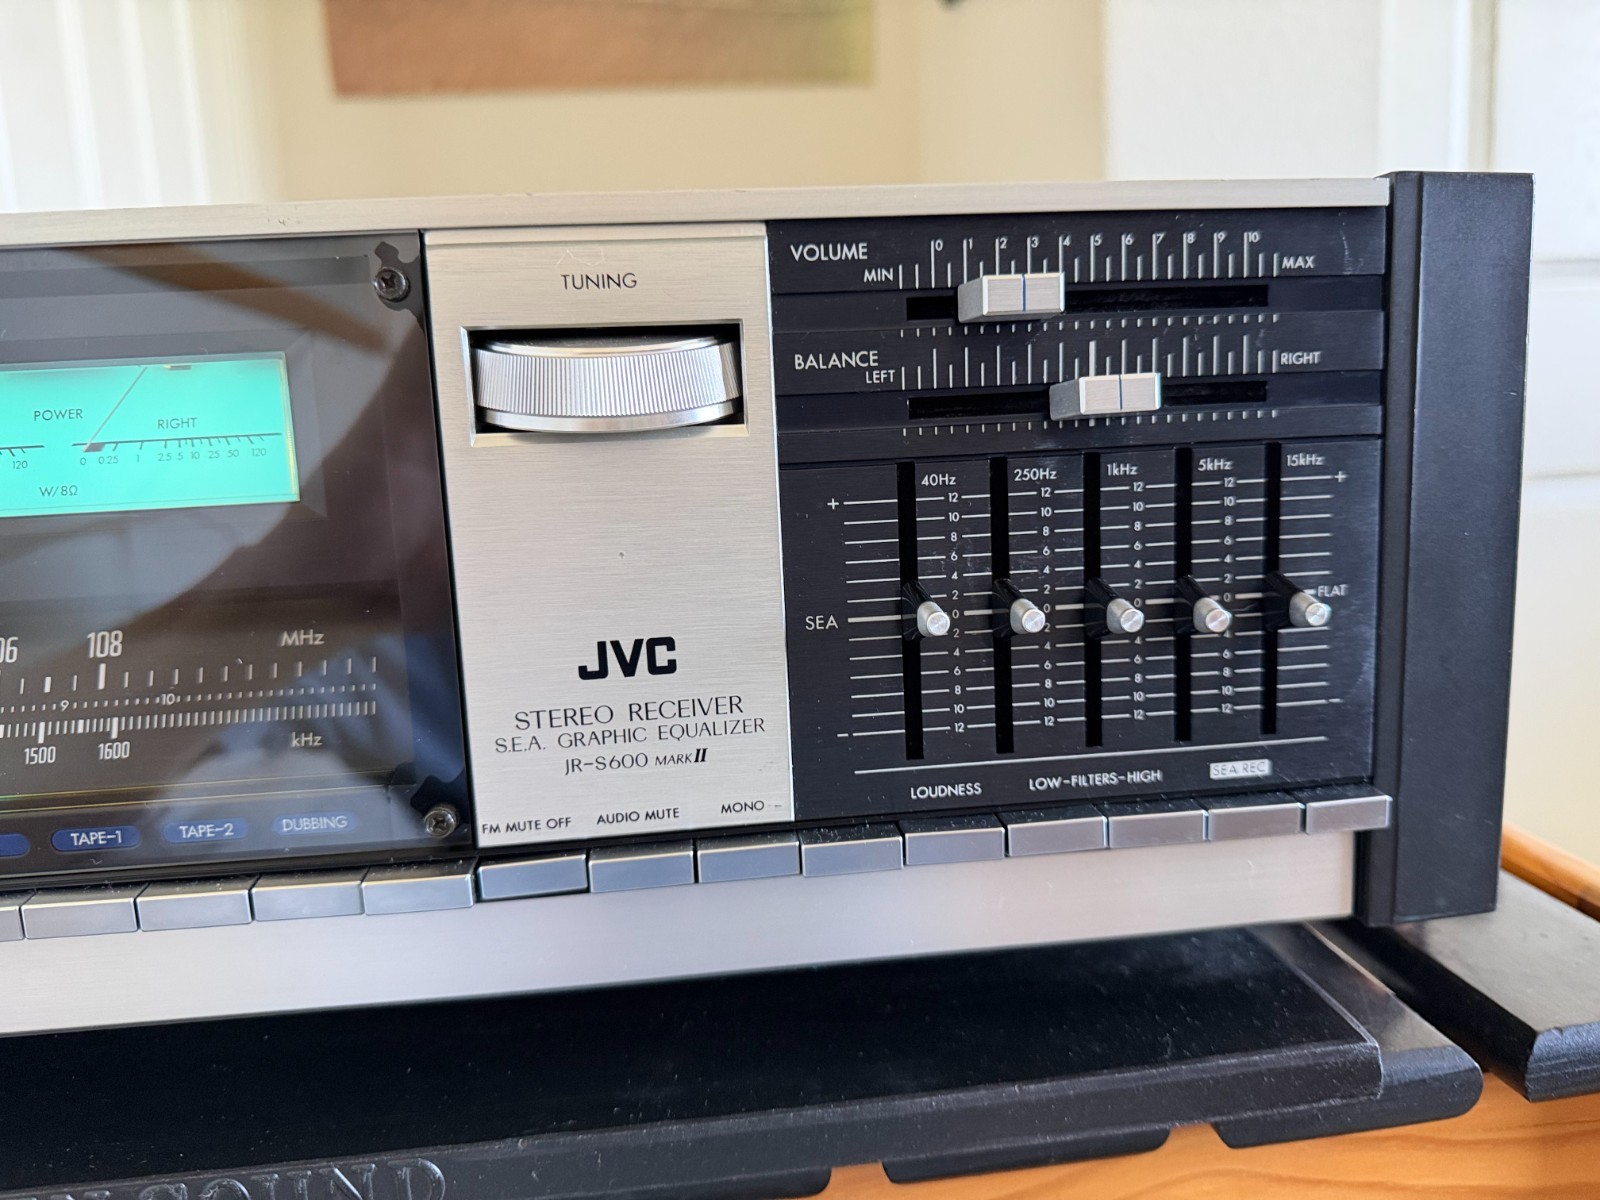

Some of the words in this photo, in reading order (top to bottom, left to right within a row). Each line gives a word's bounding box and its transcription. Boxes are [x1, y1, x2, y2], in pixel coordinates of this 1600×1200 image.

[935, 239, 944, 252] 0
[969, 237, 974, 250] 1
[999, 236, 1008, 250] 2
[1031, 235, 1039, 248] 3
[1062, 235, 1071, 248] 4
[1093, 235, 1102, 247] 5
[1124, 234, 1134, 247] 6
[1156, 233, 1165, 246] 7
[1187, 232, 1195, 244] 8
[1217, 230, 1226, 243] 9
[1247, 230, 1260, 243] 10
[790, 242, 868, 262] VOLUME
[1281, 255, 1315, 269] MAX
[863, 268, 894, 283] MIN
[560, 272, 638, 291] TUNING
[793, 350, 879, 370] BALANCE
[1280, 350, 1321, 366] RIGHT
[865, 369, 896, 385] LEFT
[33, 409, 83, 421] POWER
[157, 418, 197, 430] RIGHT
[80, 457, 86, 466] 0
[136, 455, 140, 463] 1
[178, 452, 183, 460] 5
[191, 451, 200, 460] 10
[209, 450, 220, 459] 25
[227, 449, 240, 458] 50
[252, 448, 267, 457] 120
[1286, 454, 1324, 467] 15kHz
[12, 460, 28, 470] 120
[1107, 464, 1138, 476] 1kHz
[1198, 459, 1232, 472] 5kHz
[921, 474, 957, 486] 40Hz
[1013, 469, 1057, 481] 250Hz
[1133, 482, 1144, 492] 12
[1224, 477, 1235, 488] 12
[948, 492, 959, 503] 12
[1041, 488, 1051, 498] 12
[1133, 502, 1144, 512] 10
[1224, 497, 1235, 507] 10
[948, 512, 959, 522] 10
[1041, 507, 1052, 517] 10
[1134, 521, 1142, 531] 8
[1225, 516, 1232, 526] 8
[1043, 526, 1050, 536] 8
[951, 532, 958, 542] 8
[1224, 536, 1232, 545] 6
[1043, 546, 1050, 555] 6
[1134, 541, 1142, 550] 6
[951, 552, 958, 561] 6
[1224, 555, 1231, 564] 4
[1043, 565, 1050, 574] 4
[1134, 560, 1142, 569] 4
[951, 572, 958, 581] 4
[1224, 574, 1232, 583] 2
[1135, 579, 1142, 588] 2
[1043, 584, 1050, 594] 2
[1318, 585, 1346, 596] FLAT
[952, 590, 959, 599] 2
[1223, 592, 1231, 602] 0
[1134, 598, 1141, 607] 0
[952, 609, 959, 618] 0
[1043, 604, 1051, 613] 0
[805, 616, 839, 630] SEA
[1044, 623, 1051, 632] 2
[280, 630, 325, 647] MHz
[953, 629, 960, 638] 2
[87, 630, 123, 658] 108
[1135, 636, 1142, 645] 4
[1044, 642, 1051, 650] 4
[953, 648, 960, 657] 4
[1223, 650, 1231, 659] 6
[578, 636, 677, 680] JVC
[1135, 654, 1142, 664] 6
[1044, 660, 1051, 670] 6
[954, 666, 961, 676] 6
[1223, 667, 1231, 677] 8
[1135, 673, 1142, 682] 8
[1045, 679, 1052, 688] 8
[954, 686, 961, 695] 8
[1222, 686, 1232, 696] 10
[162, 694, 176, 705] 10
[1133, 691, 1144, 701] 10
[60, 700, 69, 711] 9
[1044, 698, 1055, 707] 10
[514, 705, 613, 731] STEREO
[628, 696, 743, 721] RECEIVER
[954, 704, 965, 714] 10
[1221, 704, 1232, 713] 12
[1133, 710, 1144, 720] 12
[1044, 716, 1055, 726] 12
[954, 723, 965, 732] 12
[291, 733, 322, 748] kHz
[494, 734, 546, 754] S.E.A.
[558, 728, 647, 748] GRAPHIC
[657, 717, 765, 742] EQUALIZER
[24, 746, 56, 764] 1500
[98, 741, 130, 760] 1600
[564, 752, 648, 776] JR-S600
[1212, 763, 1237, 776] SEA
[1239, 762, 1266, 775] REC
[910, 783, 982, 800] LOUDNESS
[720, 799, 766, 814] MONO
[596, 809, 641, 825] AUDIO
[643, 806, 680, 821] MUTE
[282, 816, 347, 831] DUBBING
[482, 822, 502, 835] FM
[505, 819, 543, 833] MUTE
[547, 816, 572, 830] OFF
[179, 823, 234, 838] TAPE-2
[70, 831, 122, 847] TAPE-1
